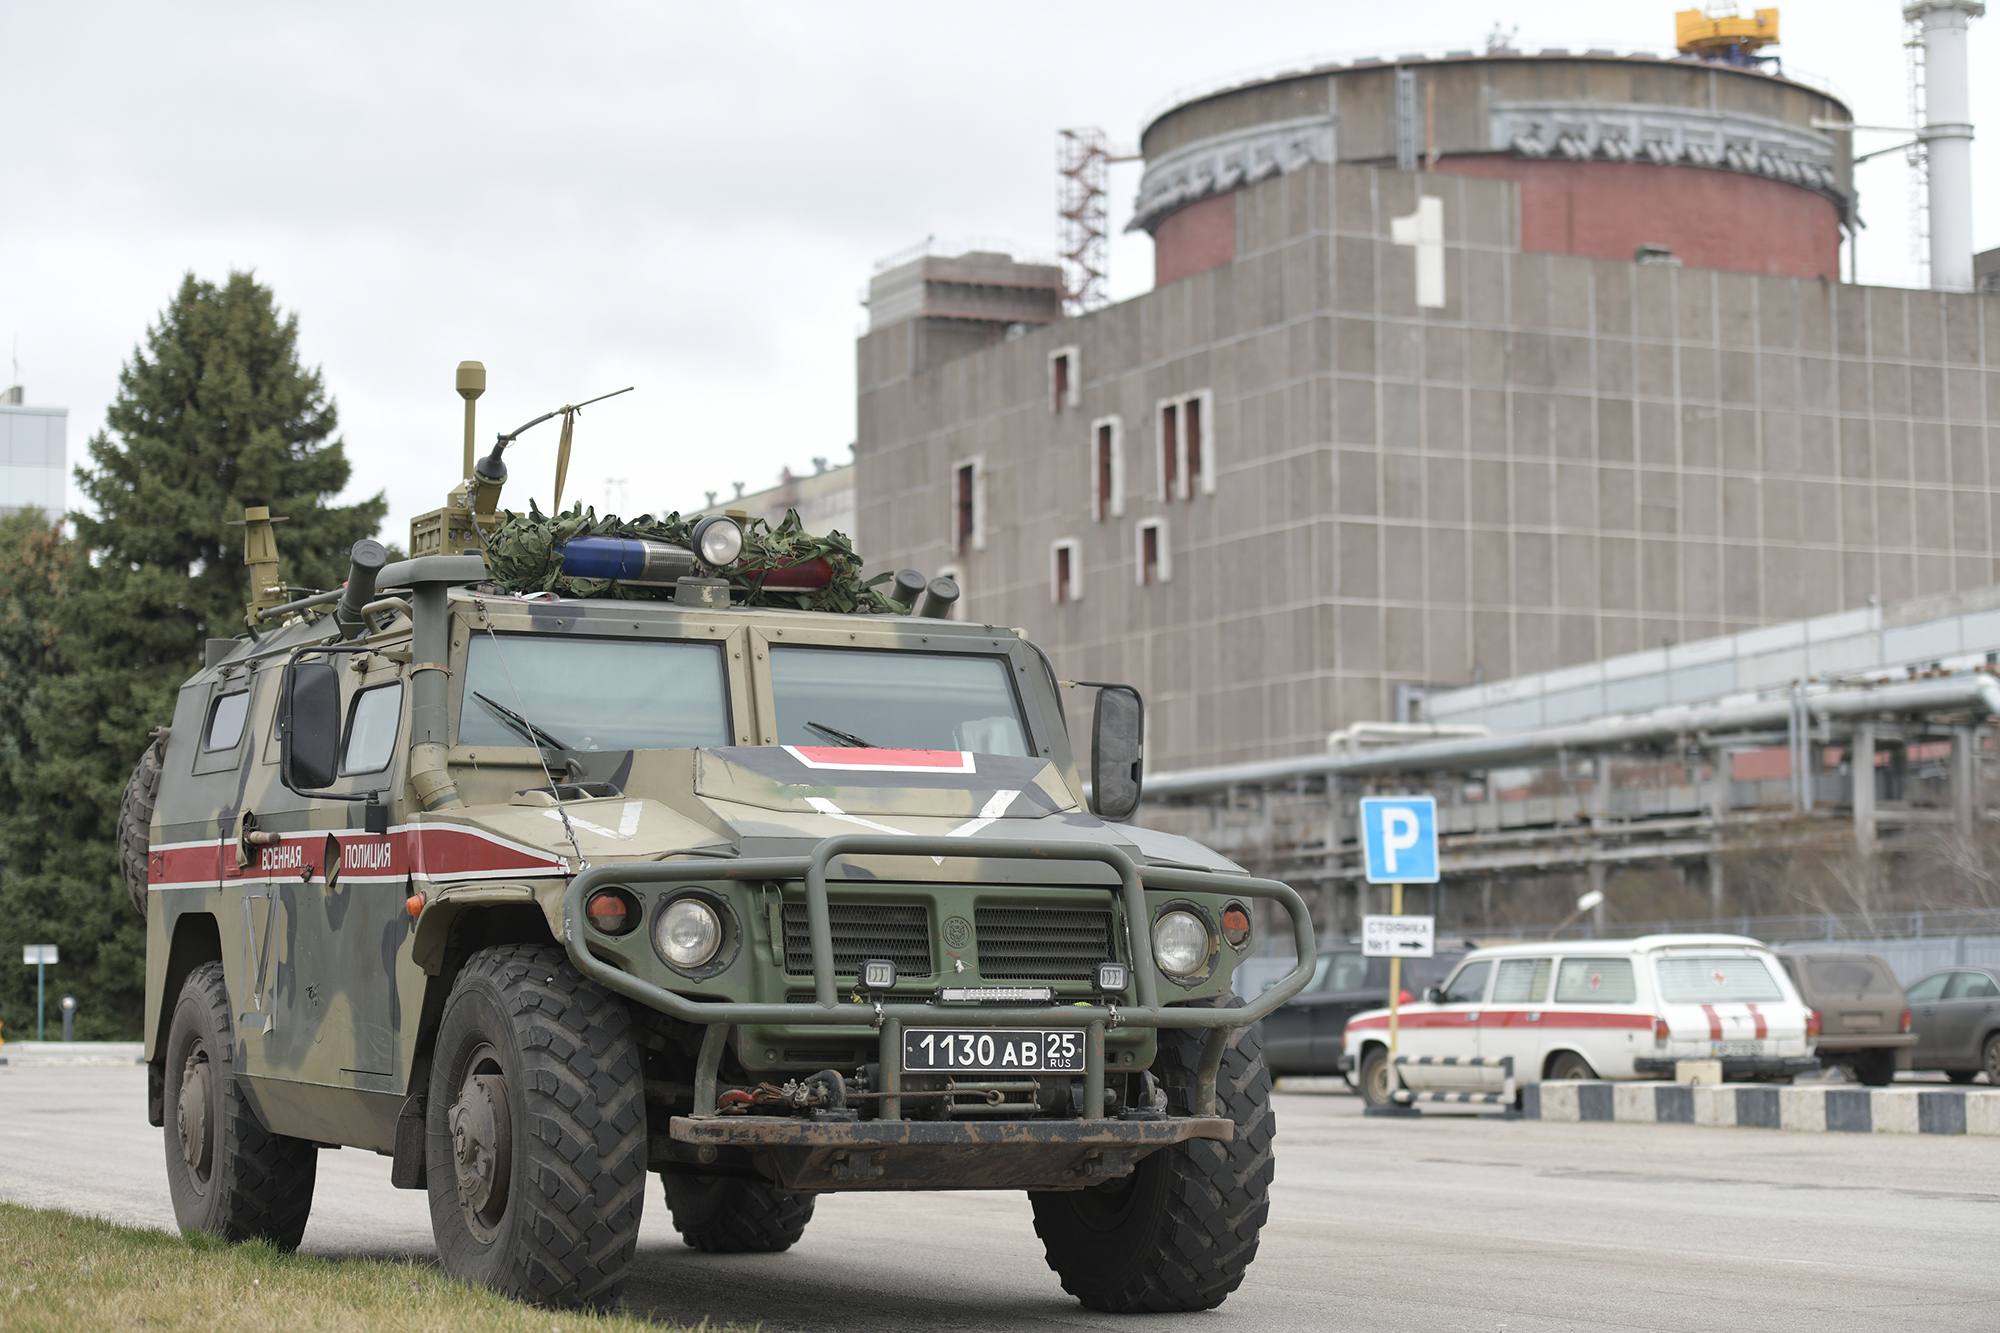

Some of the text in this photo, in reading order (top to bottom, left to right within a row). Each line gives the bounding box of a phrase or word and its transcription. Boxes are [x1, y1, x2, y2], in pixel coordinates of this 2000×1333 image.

[1390, 194, 1445, 308] 1
[261, 842, 391, 870] ВОЕННАЯ ПОЛИЦИЯ
[1382, 807, 1420, 873] P
[919, 1034, 995, 1066] 1130
[1047, 1034, 1075, 1058] 25
[1050, 1059, 1071, 1068] RUS
